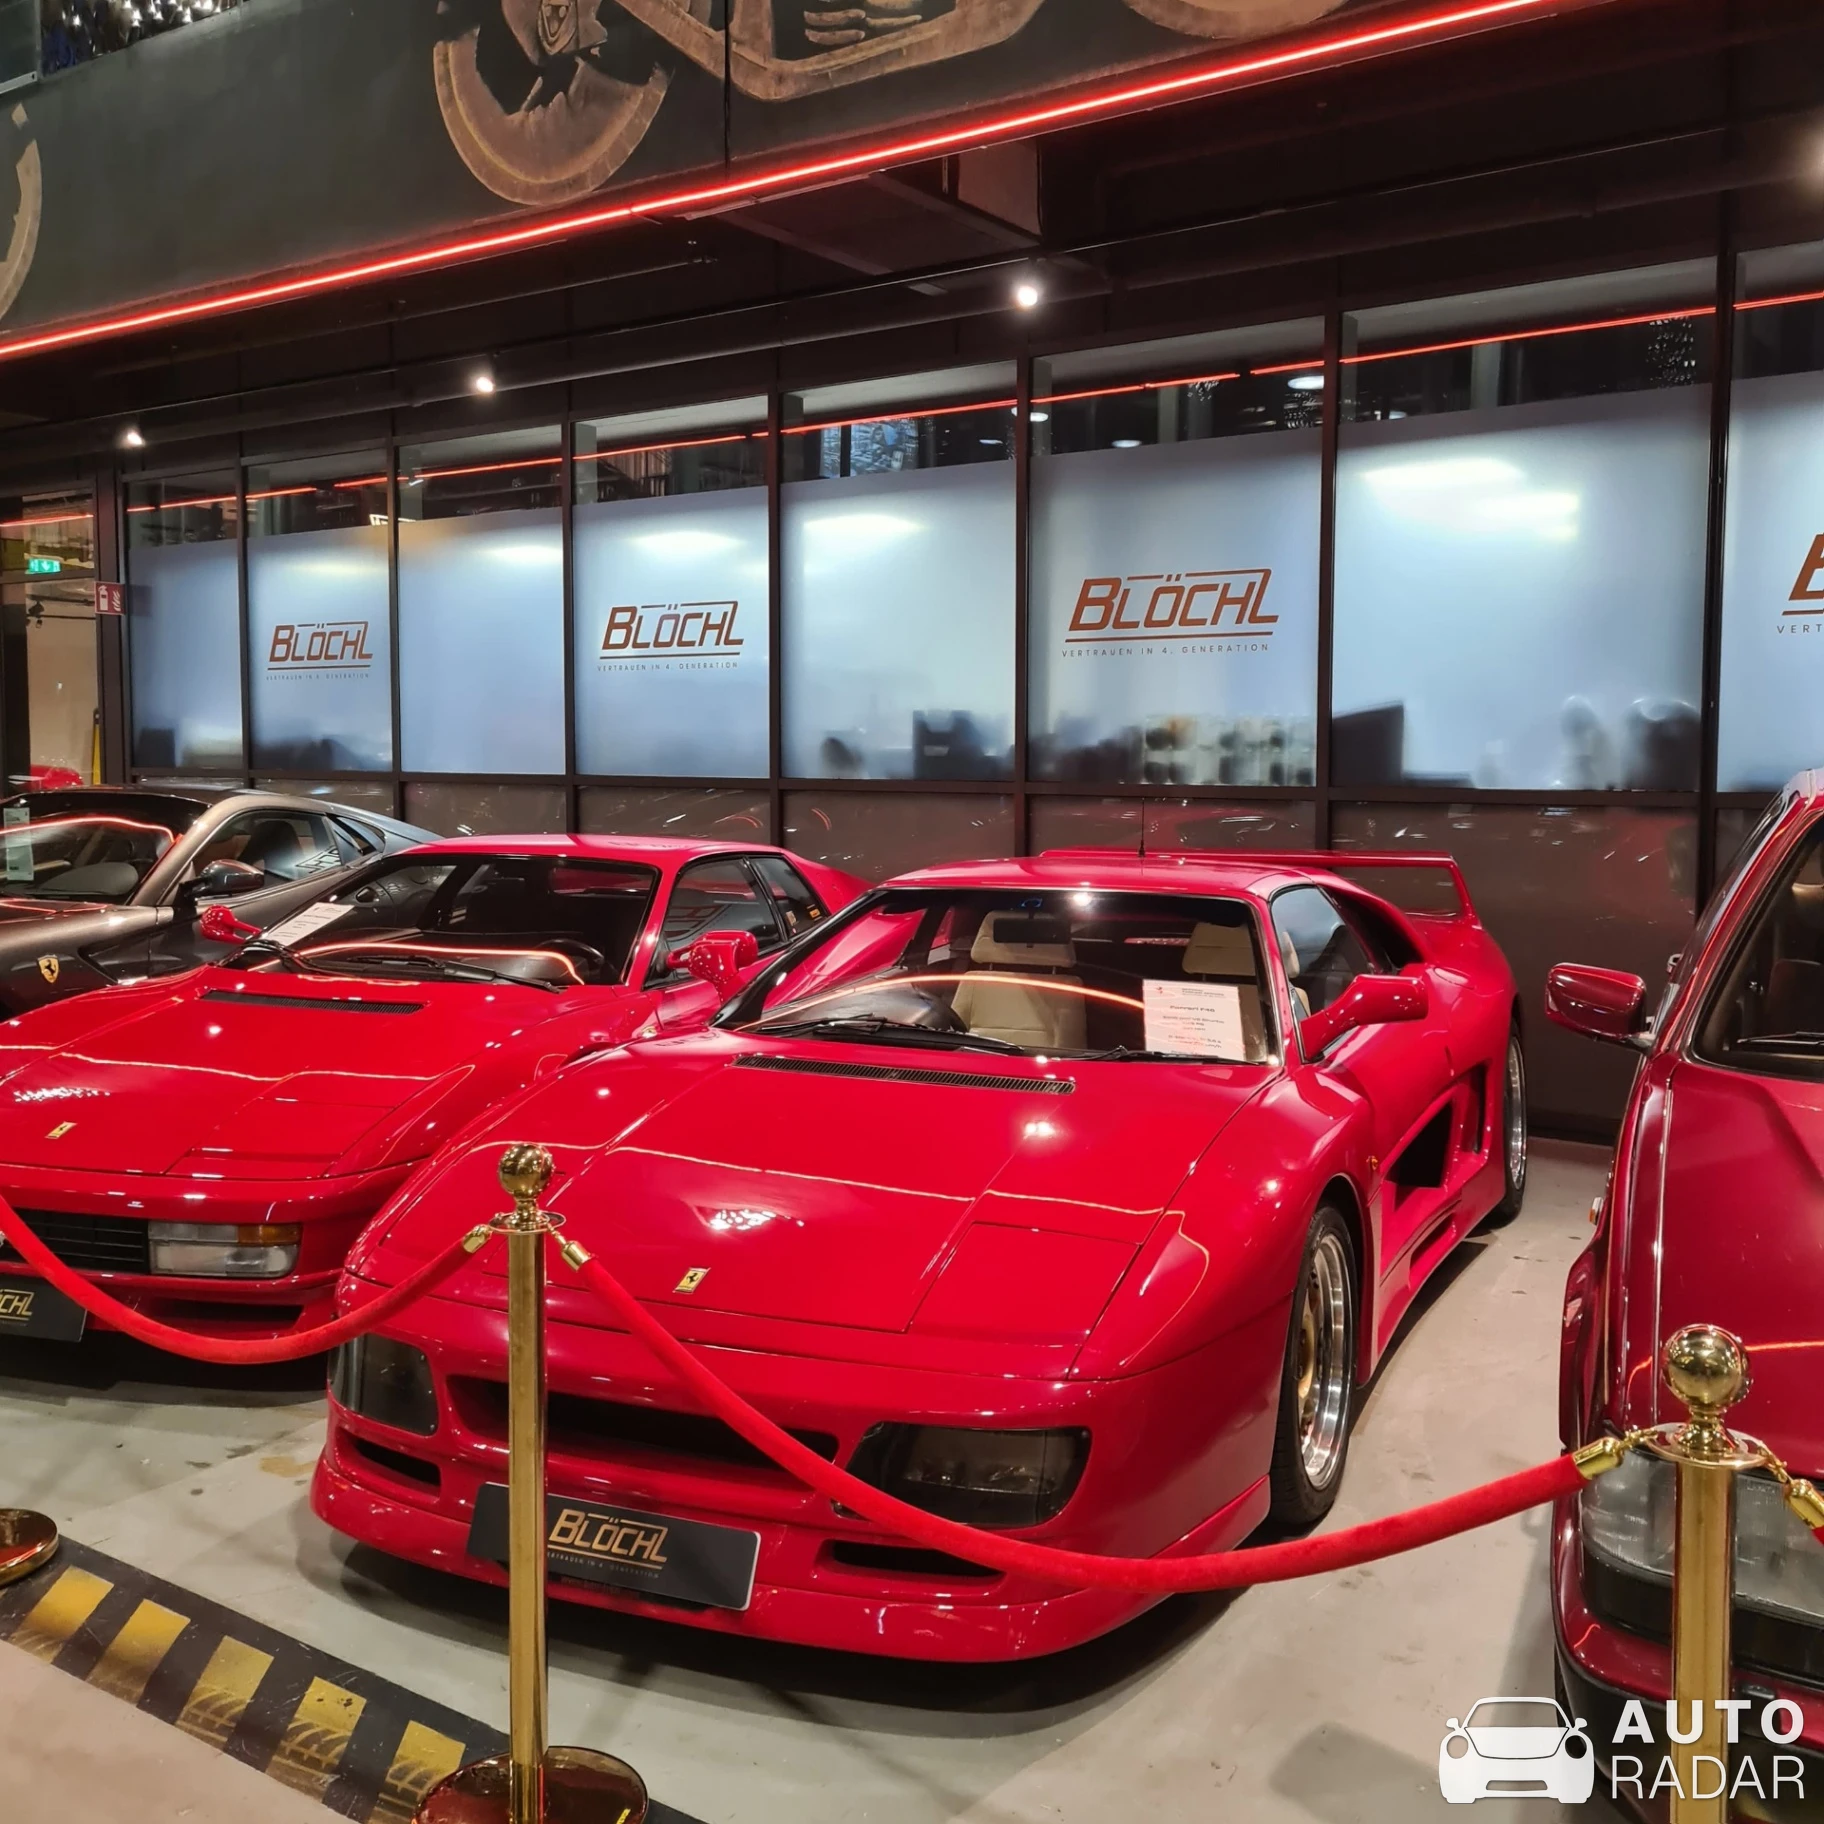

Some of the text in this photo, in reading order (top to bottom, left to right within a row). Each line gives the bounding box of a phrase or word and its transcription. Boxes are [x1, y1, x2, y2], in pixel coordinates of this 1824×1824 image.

[1069, 568, 1279, 631] BLÖCHL
[269, 621, 373, 662] BLÖCHL
[602, 601, 744, 650] BLÖCHL
[597, 664, 646, 672] VERTRAUEN
[1062, 647, 1133, 657] VERTRAUEN
[1141, 647, 1153, 655] IN
[1182, 644, 1269, 654] GENERATION
[0, 1289, 35, 1316] CHL
[549, 1508, 668, 1563] BLÖCHL
